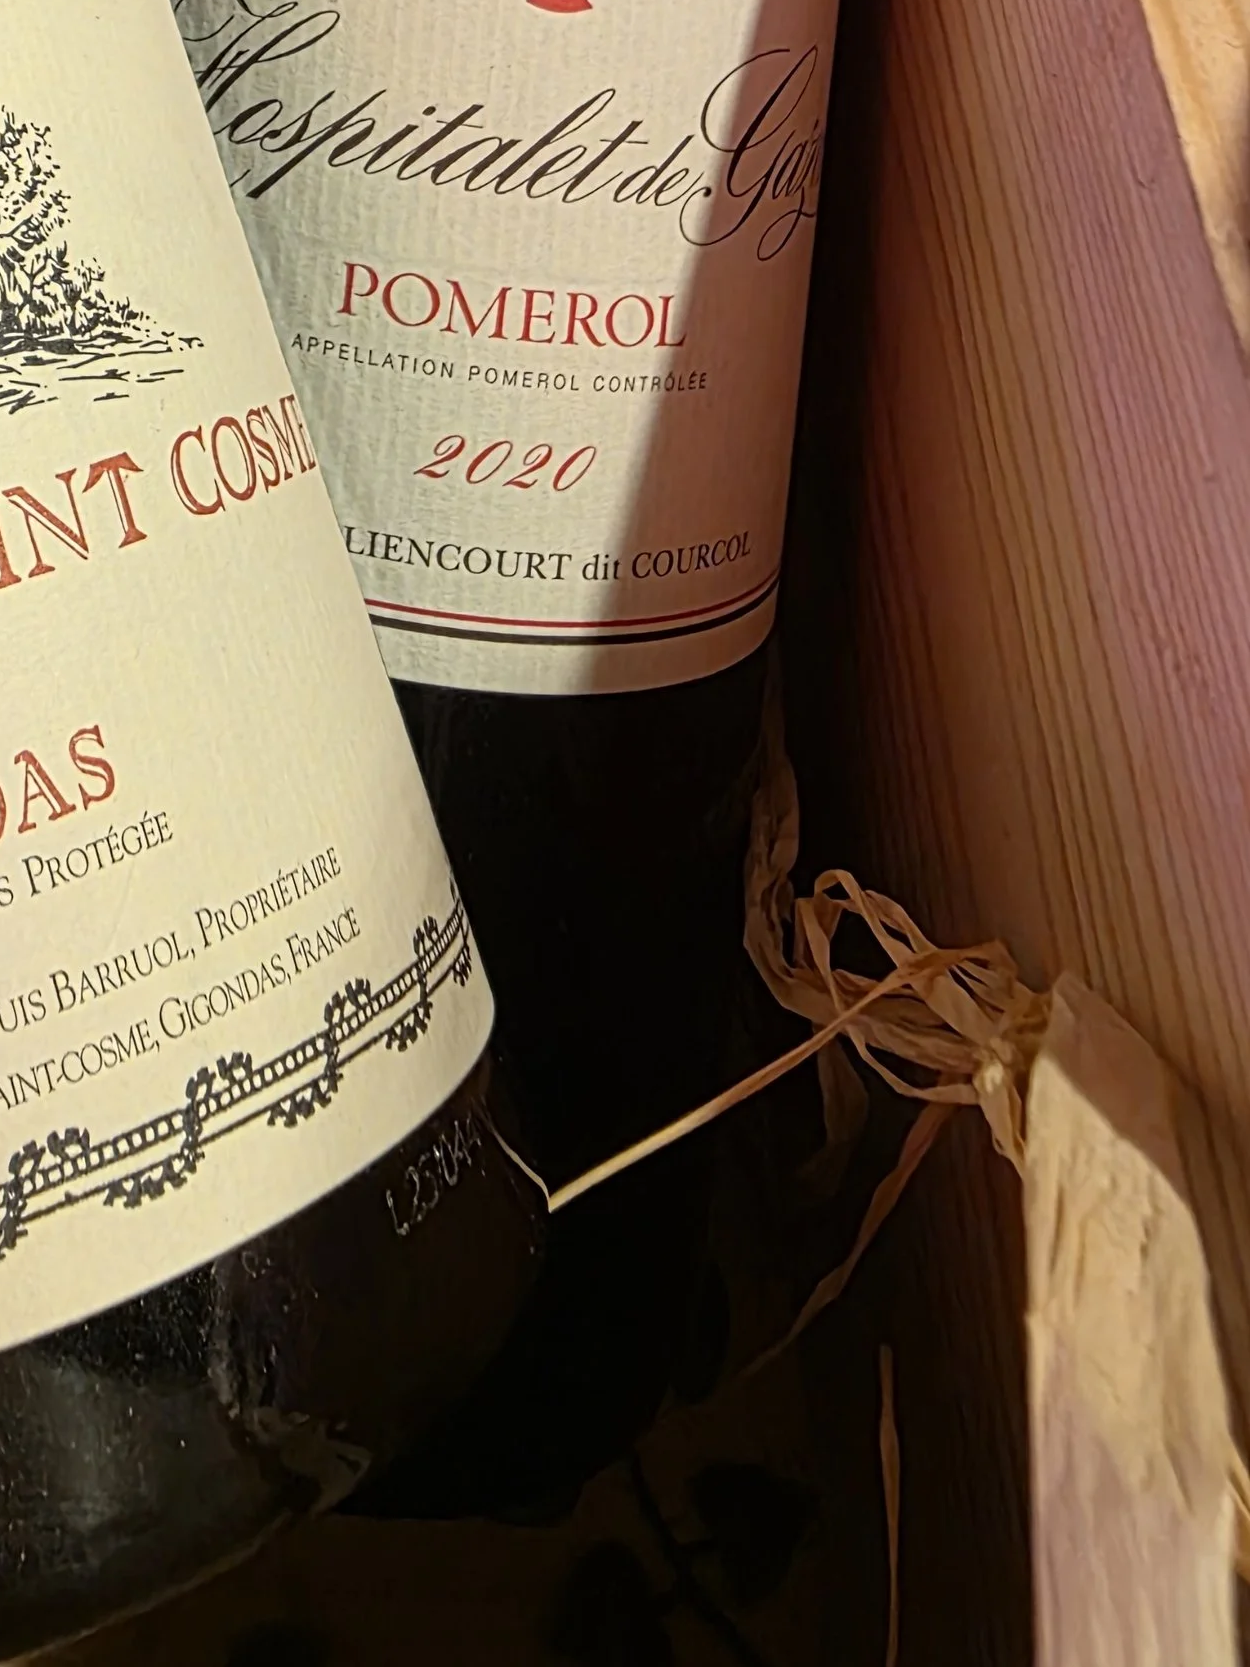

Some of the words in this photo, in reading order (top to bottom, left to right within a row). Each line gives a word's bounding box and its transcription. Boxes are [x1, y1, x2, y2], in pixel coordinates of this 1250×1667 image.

[613, 133, 703, 207] de
[337, 260, 688, 349] POMEROL
[291, 333, 455, 379] APPELLATION
[467, 364, 581, 392] POMEROL
[592, 369, 708, 393] CONTRÔLÉE
[412, 434, 598, 492] 2020
[343, 526, 573, 581] LIENCOURT
[581, 552, 620, 582] dit
[631, 530, 751, 580] COURCOL
[21, 810, 175, 896] PROTÉGÉE
[49, 932, 196, 1013] BARRUOL,
[195, 846, 342, 949] PROPRIÉTAIRE
[286, 906, 362, 973] FRANCE
